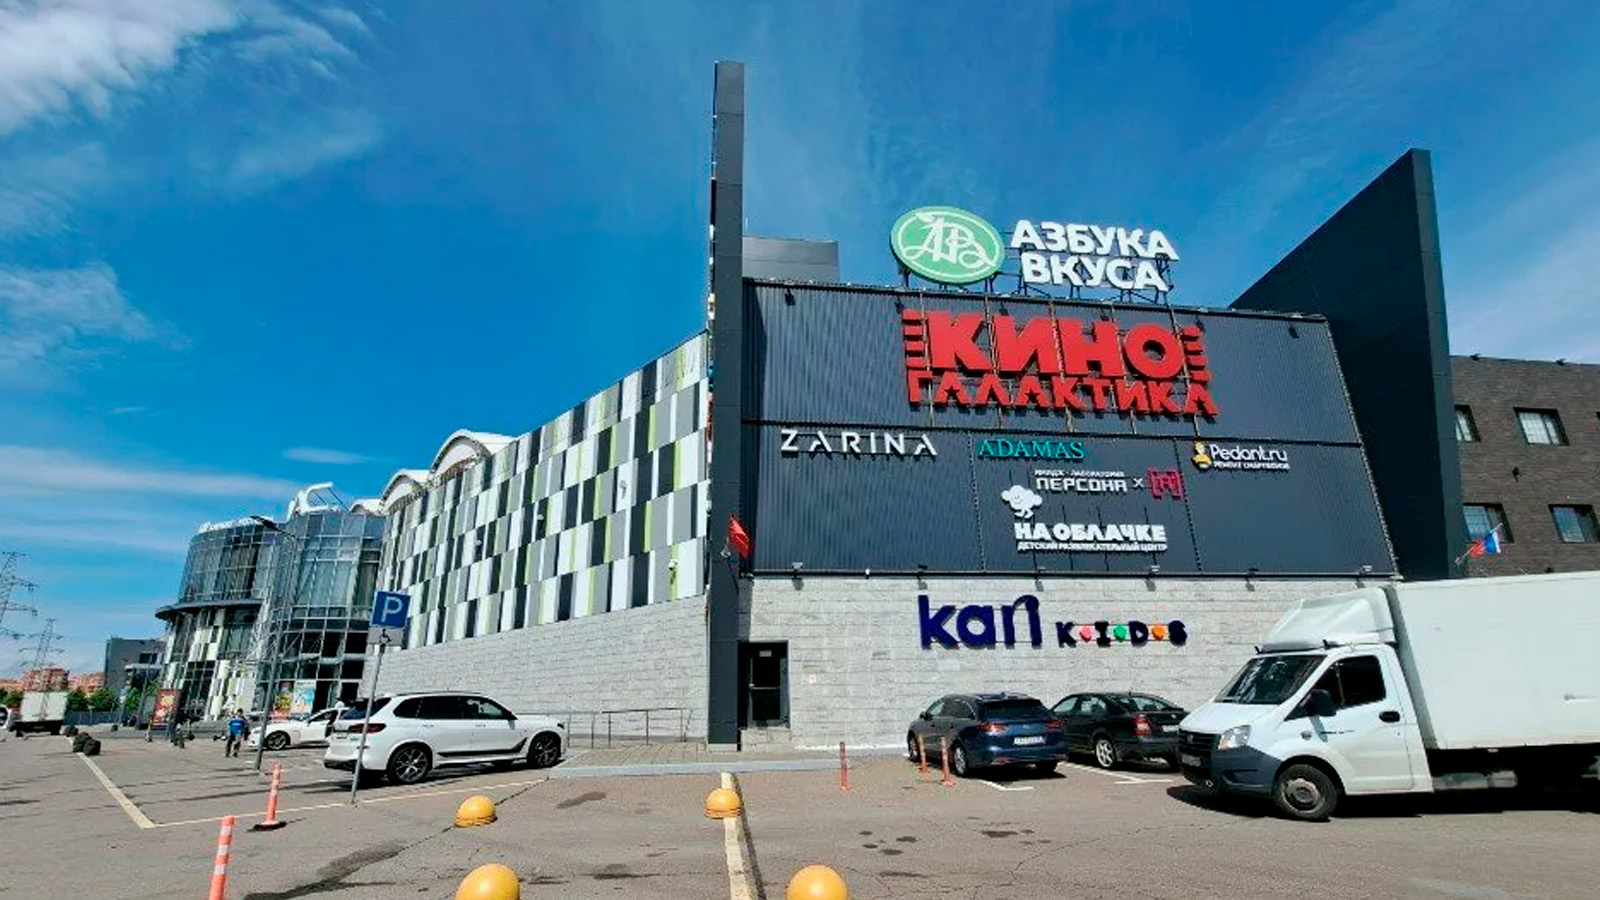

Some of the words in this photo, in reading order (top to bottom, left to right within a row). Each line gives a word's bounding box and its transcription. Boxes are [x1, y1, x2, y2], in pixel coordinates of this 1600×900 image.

[1011, 220, 1179, 261] АЗБУКА
[1021, 252, 1169, 292] ВКУСА
[924, 311, 1185, 379] КИНО
[908, 370, 1218, 416] ГАЛАКТИКА
[780, 429, 938, 456] ZARINA
[979, 438, 1085, 460] ADAMAS
[1209, 443, 1288, 461] Pedant.ru
[1035, 477, 1128, 492] ПЕРСОНА
[1014, 523, 1052, 540] НА
[1052, 523, 1167, 542] ОБЛАЧКЕ
[381, 596, 403, 623] P
